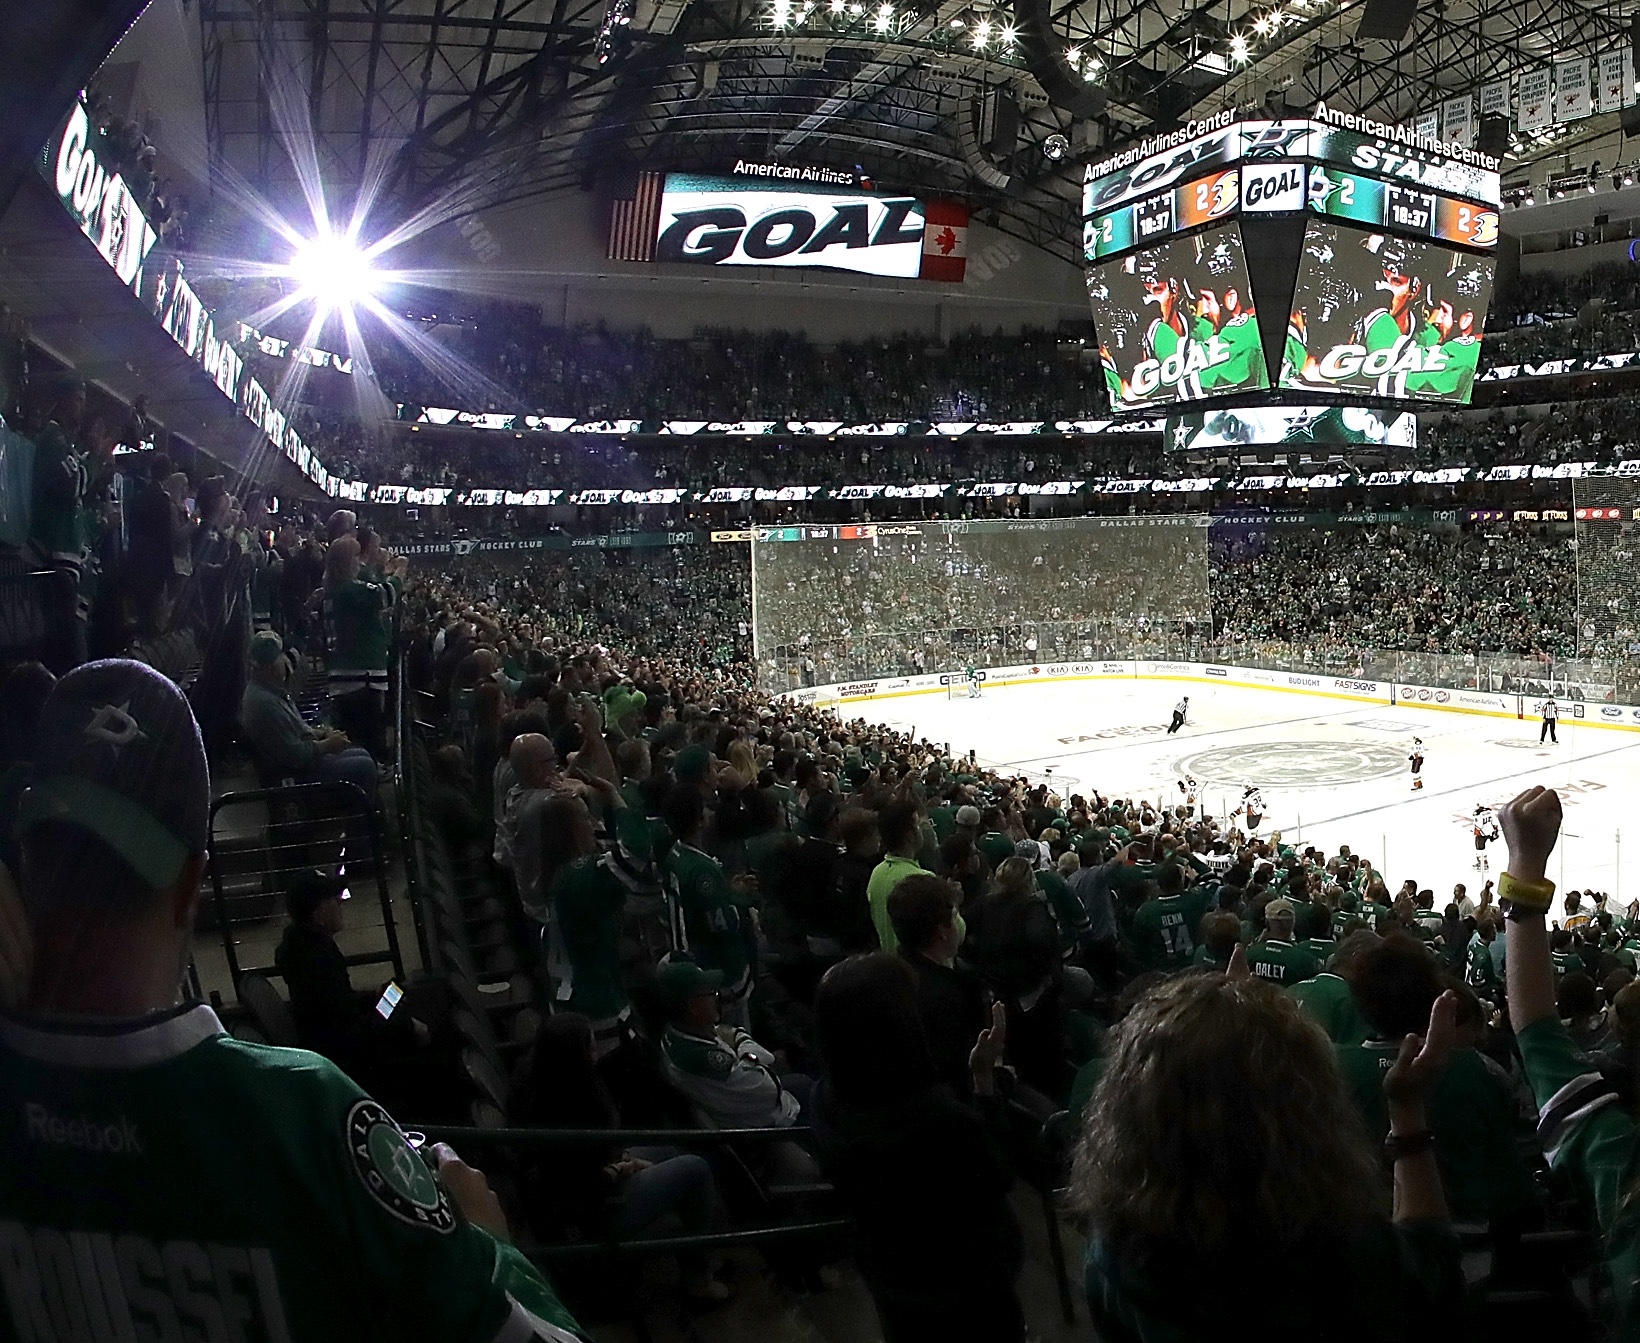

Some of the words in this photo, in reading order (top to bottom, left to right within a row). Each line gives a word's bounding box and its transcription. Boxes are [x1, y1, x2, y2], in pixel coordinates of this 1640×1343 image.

[734, 159, 800, 180] American
[801, 165, 853, 186] Airlines
[1246, 168, 1300, 206] GOAL
[1103, 218, 1113, 243] 2
[1196, 184, 1209, 211] 2
[1340, 178, 1354, 205] 2
[1458, 208, 1471, 232] 2
[657, 197, 924, 264] GOAL
[1131, 336, 1231, 396] GOAL
[1319, 340, 1450, 381] GOAL
[1100, 519, 1144, 527] DALLAS
[1224, 516, 1270, 524] HOCKEY
[388, 545, 421, 555] DALLAS
[424, 544, 451, 553] STARS
[480, 541, 516, 550] HOCKEY
[518, 540, 543, 549] CLUB
[571, 539, 597, 547] STARS
[940, 671, 986, 686] GEIO
[1288, 677, 1301, 685] BUD
[1302, 678, 1320, 687] LIGHT
[1334, 680, 1377, 692] FASTSIGNS
[1160, 925, 1194, 954] 14
[1255, 961, 1287, 979] DALEY
[25, 1101, 144, 1154] Reebok
